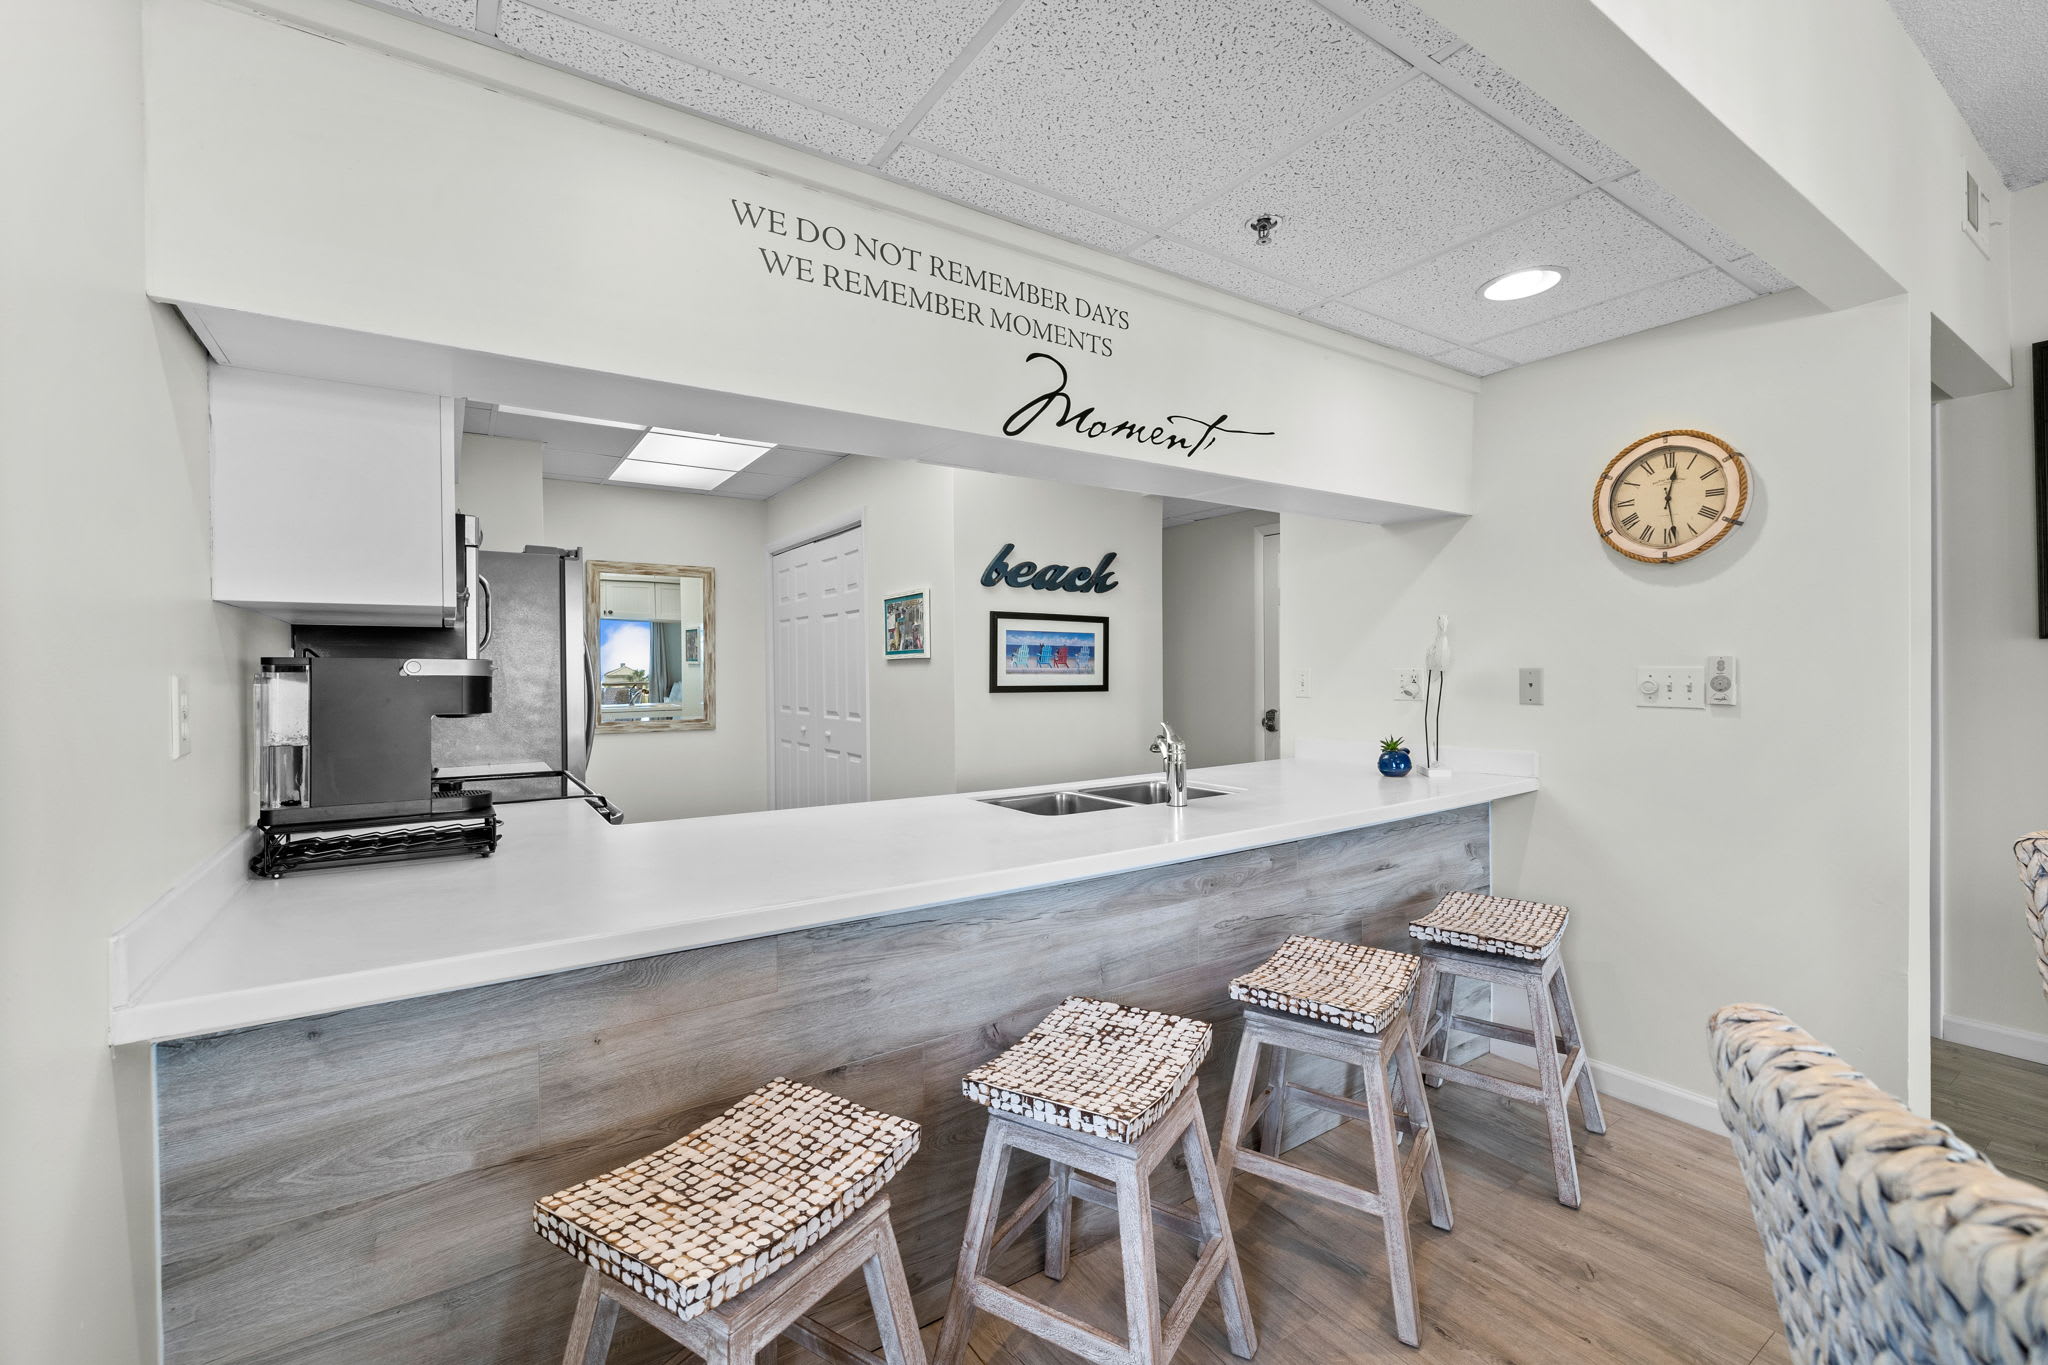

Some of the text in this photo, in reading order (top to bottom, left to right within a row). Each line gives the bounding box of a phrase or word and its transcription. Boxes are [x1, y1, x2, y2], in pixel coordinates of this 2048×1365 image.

[731, 198, 1130, 331] WE DO NOT REMEMBER DAYS
[758, 247, 1113, 358] WE REMEMBER MOMENTS
[980, 542, 1119, 594] beach
